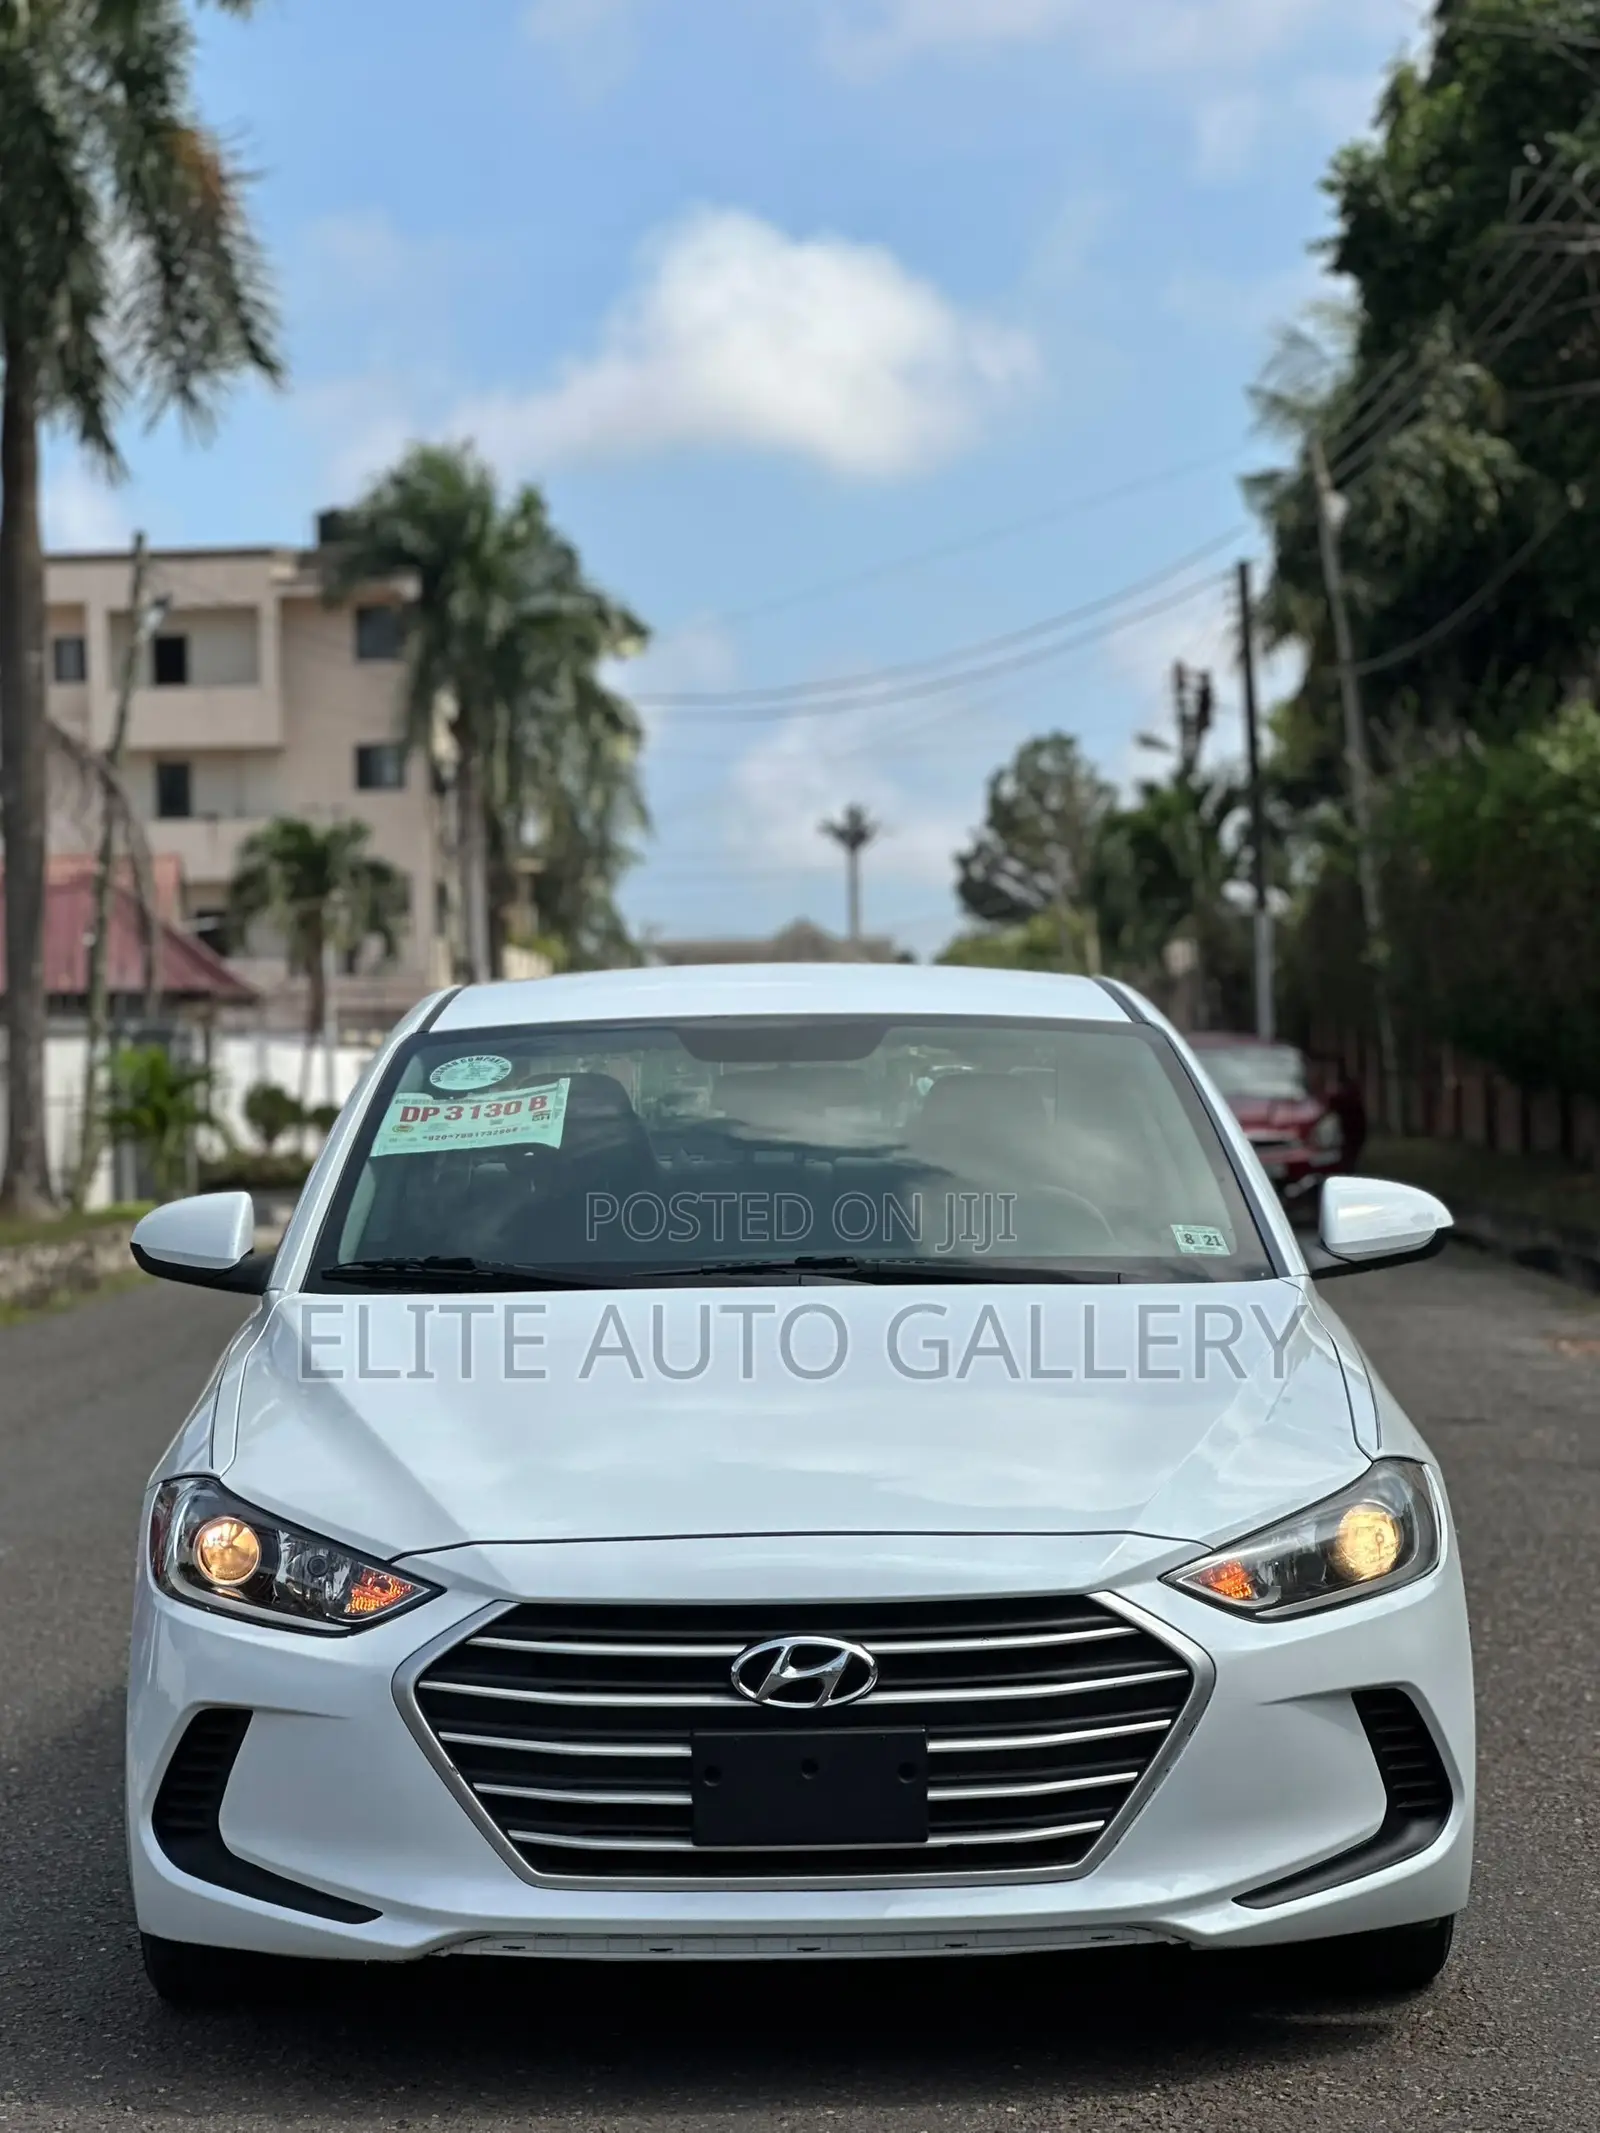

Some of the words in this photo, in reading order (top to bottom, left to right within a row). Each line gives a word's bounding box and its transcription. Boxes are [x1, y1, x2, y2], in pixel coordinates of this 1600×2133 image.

[400, 1106, 440, 1123] DP
[444, 1100, 522, 1121] 3130
[529, 1095, 548, 1111] B
[1184, 1233, 1195, 1245] 8
[1203, 1234, 1223, 1247] 21
